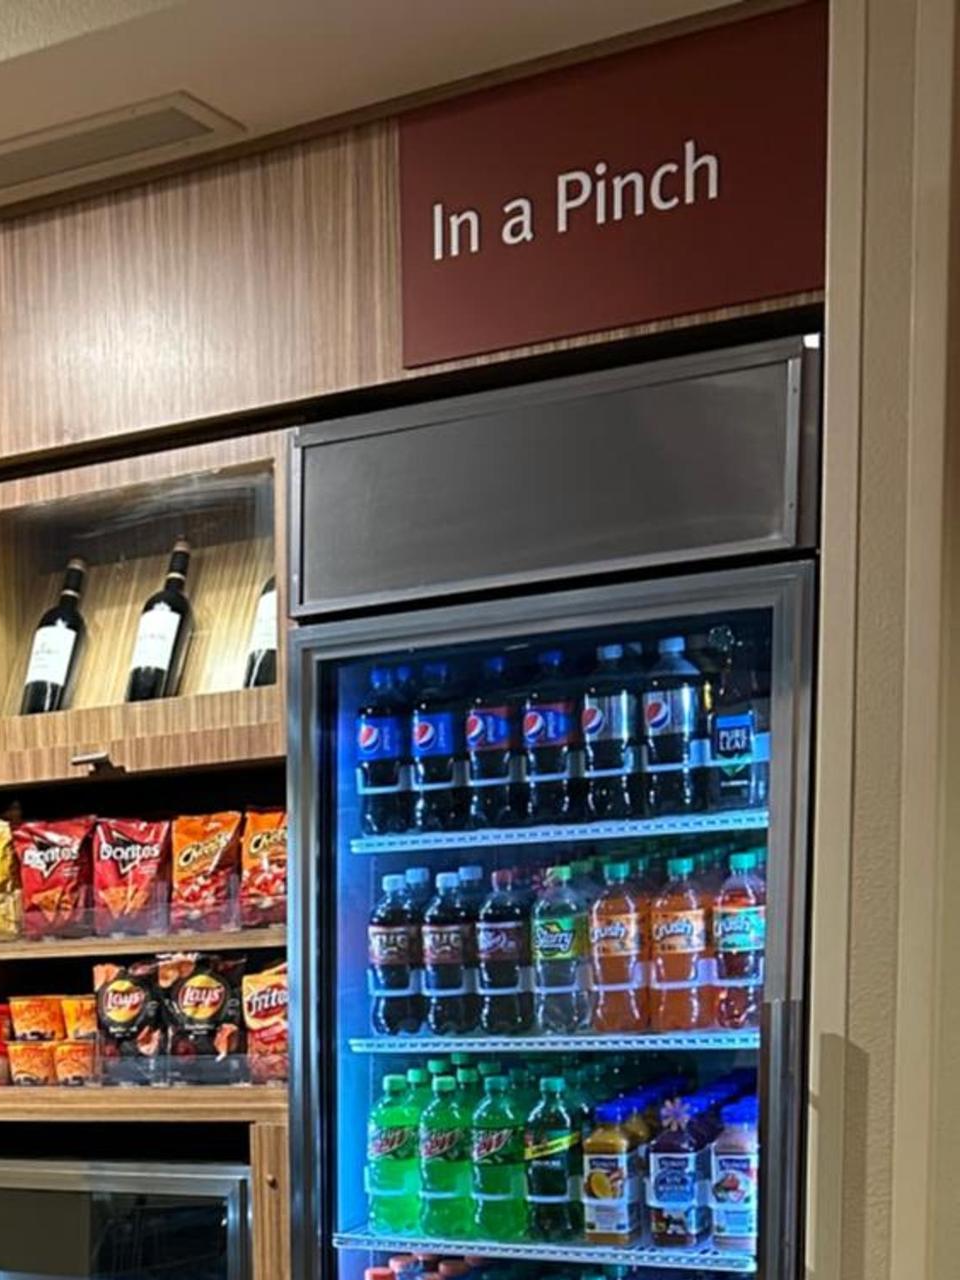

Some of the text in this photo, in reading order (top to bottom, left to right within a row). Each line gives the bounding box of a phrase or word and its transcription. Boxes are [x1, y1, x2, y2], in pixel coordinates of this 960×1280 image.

[433, 139, 719, 260] In a Pinch
[23, 844, 79, 865] Doritos
[100, 841, 161, 861] Doritos
